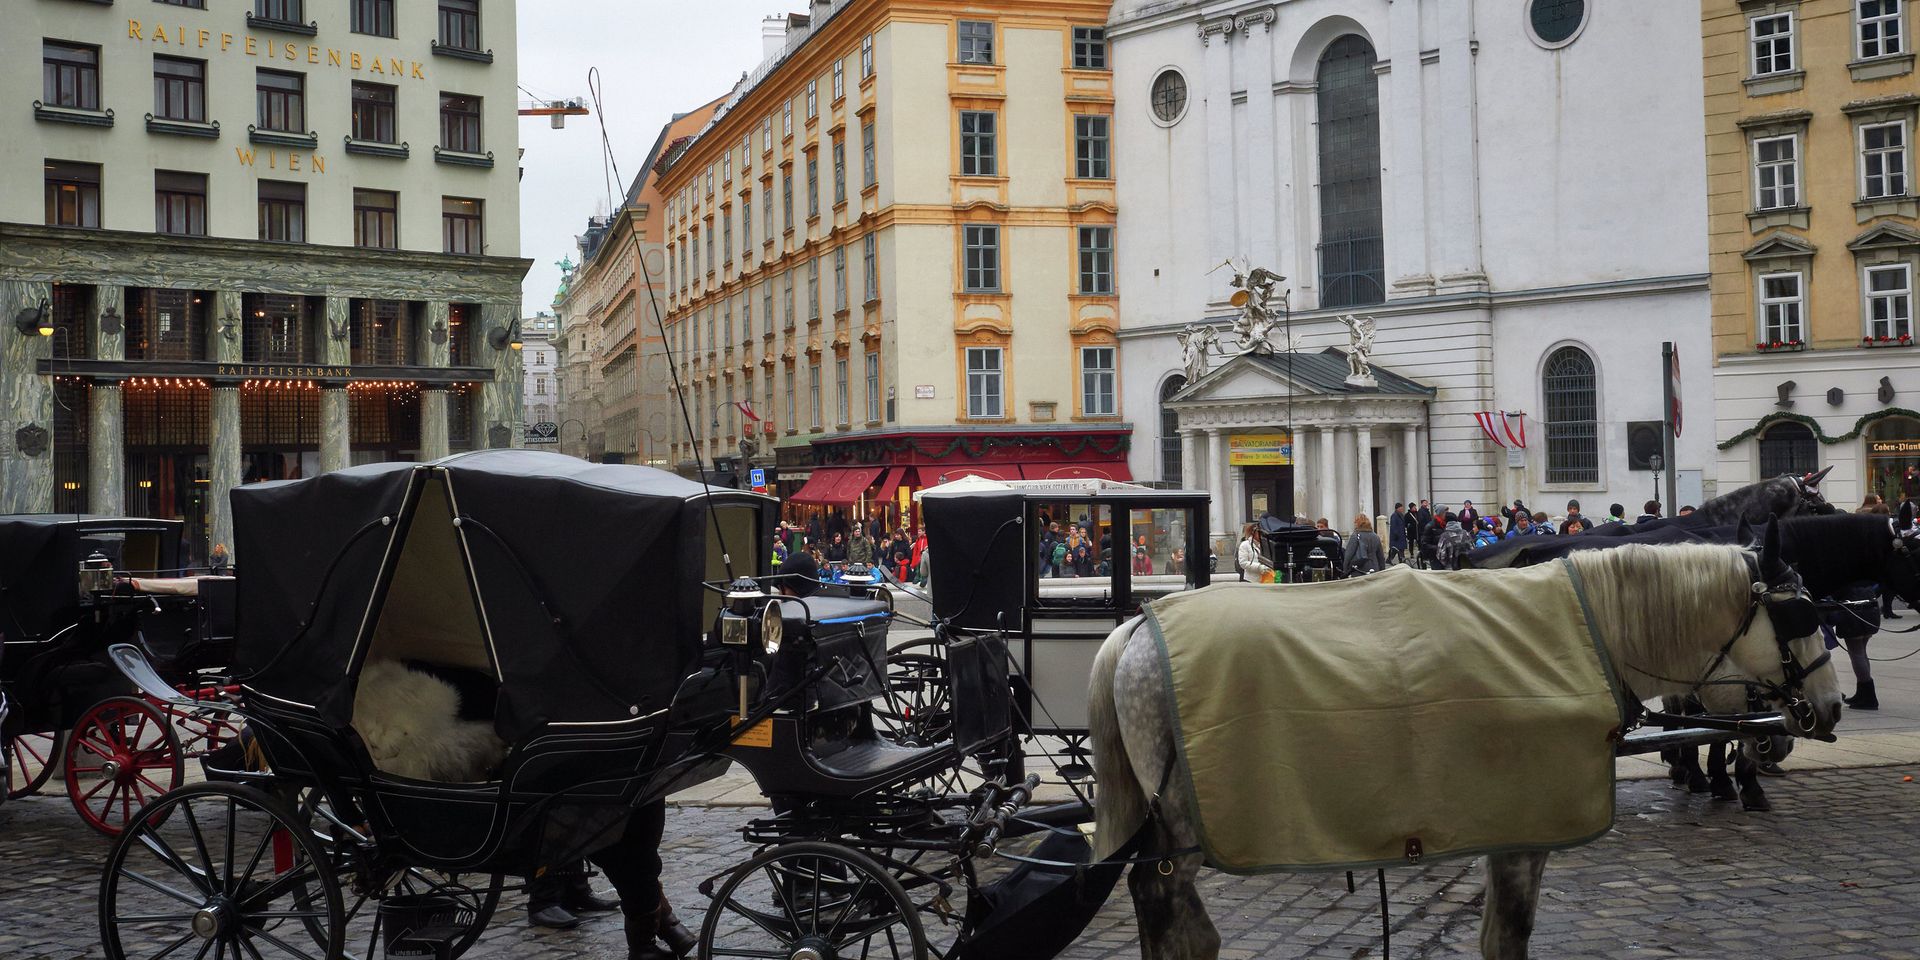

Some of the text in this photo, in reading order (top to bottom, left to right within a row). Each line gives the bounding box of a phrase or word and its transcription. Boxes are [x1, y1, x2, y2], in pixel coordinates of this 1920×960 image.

[128, 18, 425, 79] RAIFFEISENBANK
[235, 146, 326, 174] WIEN
[218, 366, 351, 377] RAIFFEISENBANK
